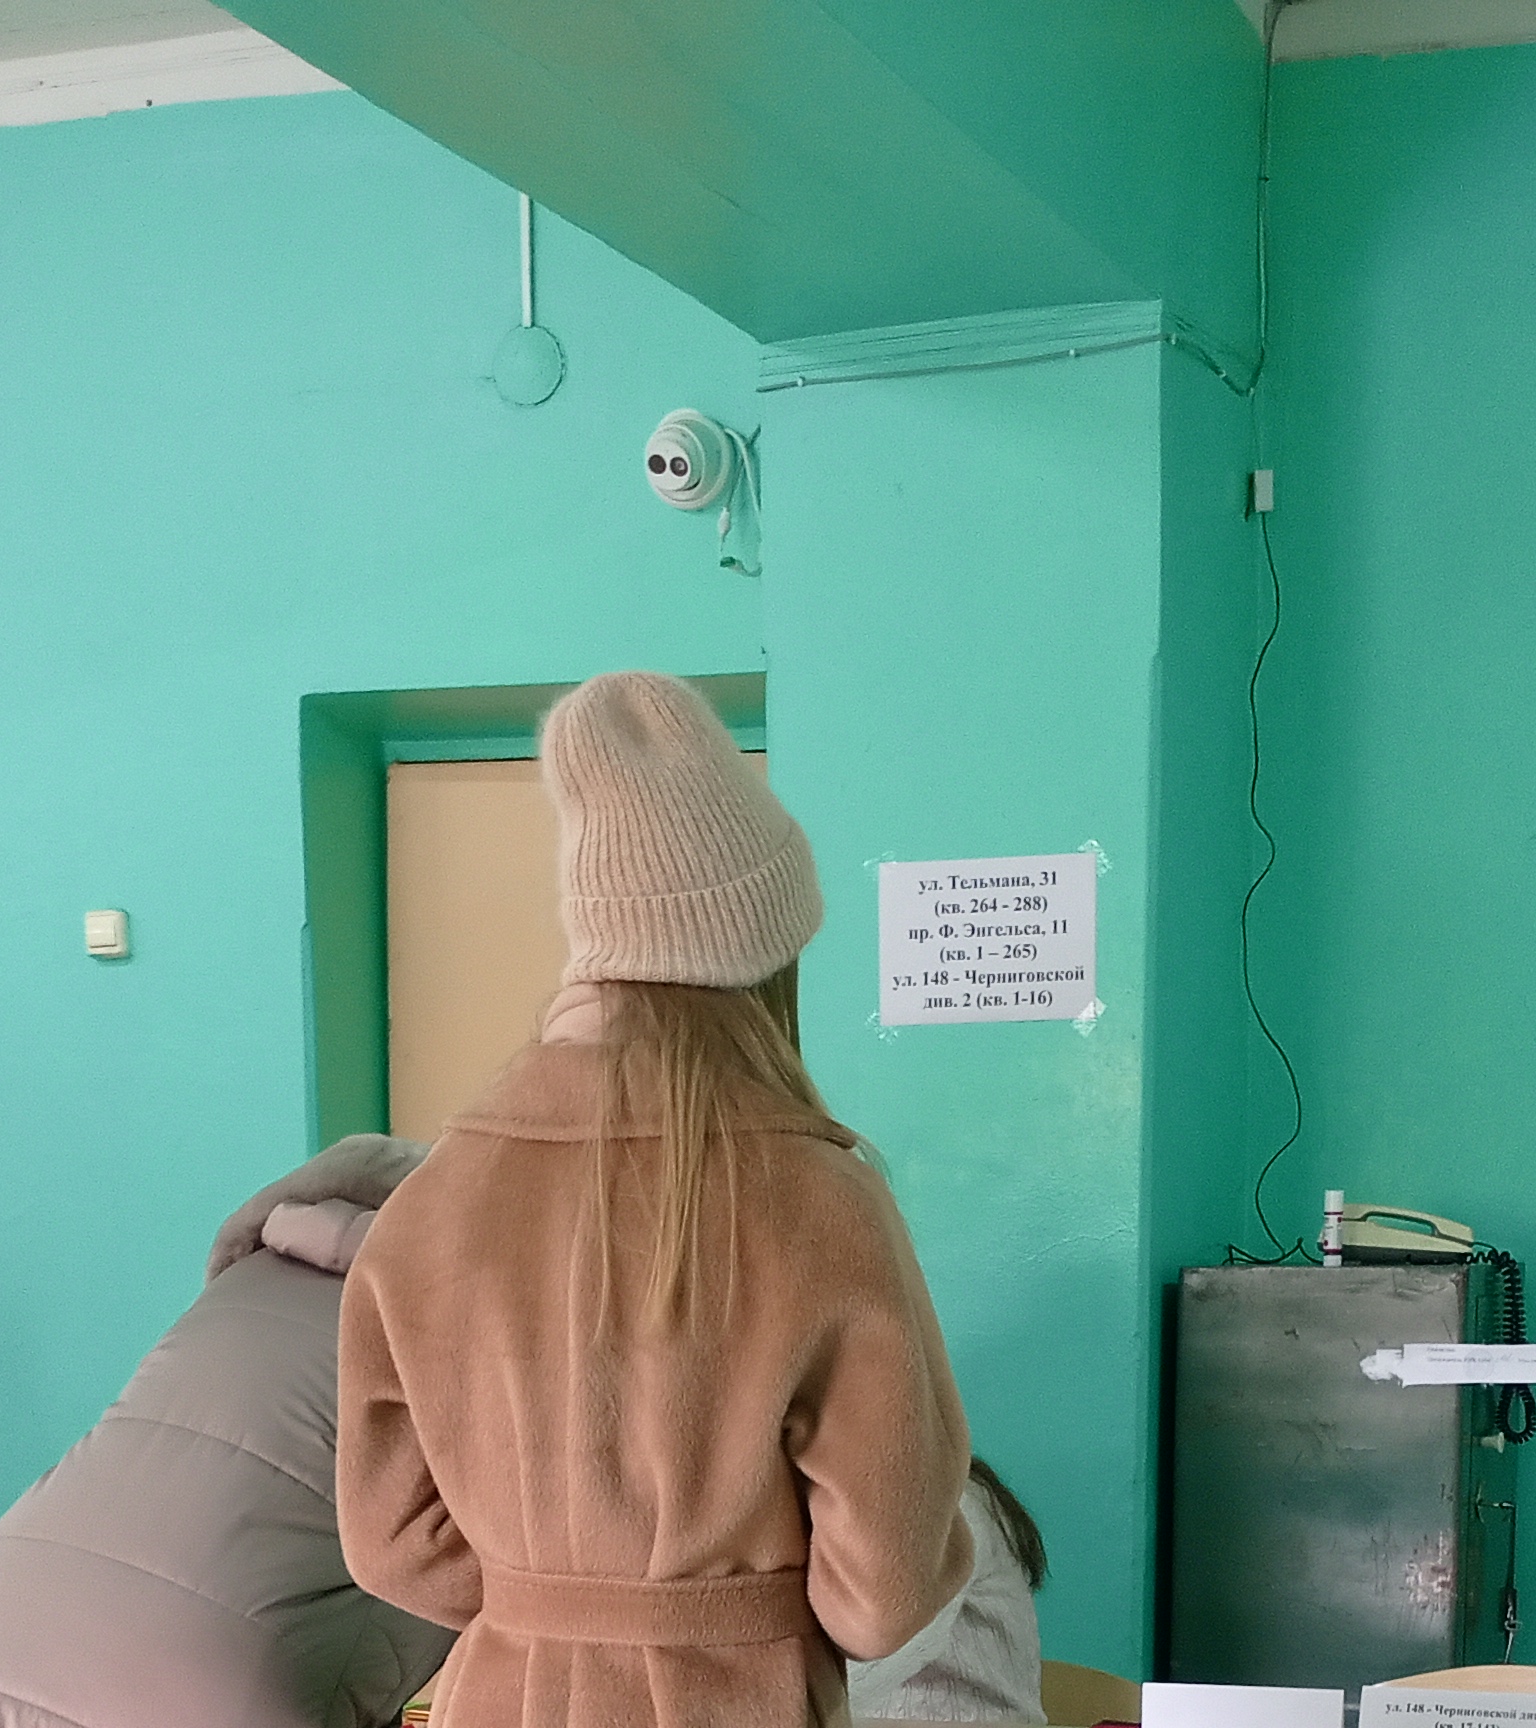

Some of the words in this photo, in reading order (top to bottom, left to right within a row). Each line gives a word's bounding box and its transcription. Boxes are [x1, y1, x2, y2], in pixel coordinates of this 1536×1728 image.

[919, 880, 943, 895] ул.
[948, 875, 1035, 890] Тельмана,
[1039, 871, 1057, 886] 31
[934, 900, 966, 918] (кв.
[970, 898, 998, 914] 264
[1014, 896, 1048, 914] 288)
[908, 928, 934, 943] пр.
[938, 924, 959, 939] Ф.
[963, 922, 1046, 938] Энгельса,
[1052, 919, 1068, 934] 11
[939, 947, 971, 964] (кв.
[977, 946, 983, 960] 1
[1003, 944, 1038, 961] 265)
[892, 975, 917, 991] ул.
[923, 971, 949, 986] 148
[965, 966, 1085, 988] Черниговской
[923, 995, 957, 1010] див.
[962, 993, 971, 1007] 2
[976, 993, 1008, 1010] (кв.
[1014, 990, 1053, 1007] 1-16)
[1386, 1704, 1402, 1714] ул.
[1406, 1703, 1425, 1714] 148
[1435, 1705, 1517, 1719] Черниговской
